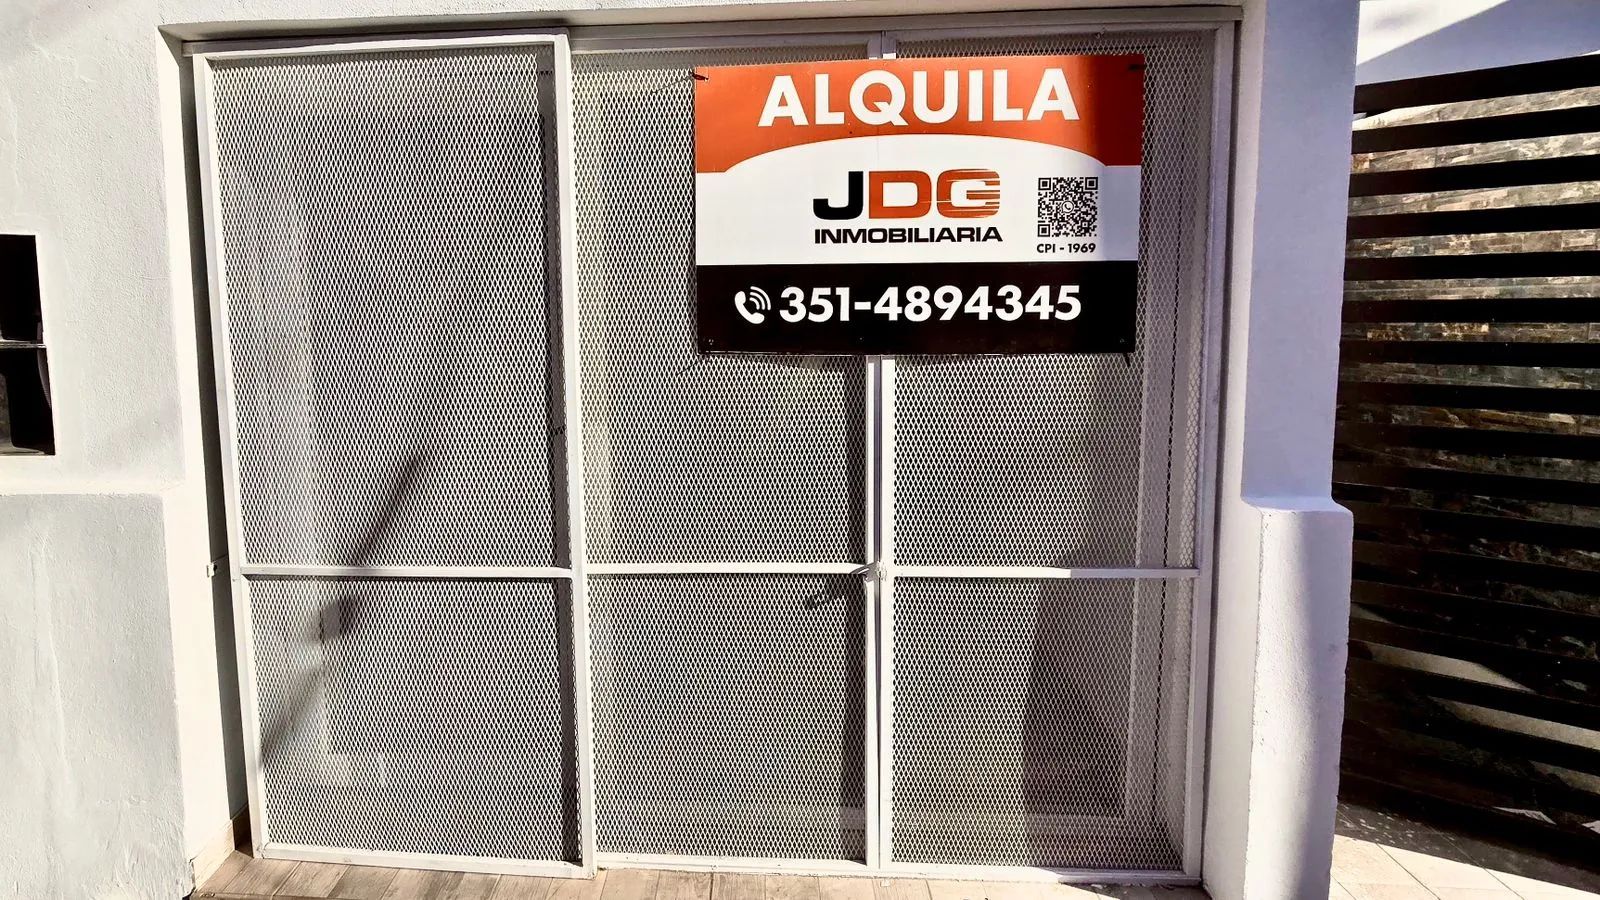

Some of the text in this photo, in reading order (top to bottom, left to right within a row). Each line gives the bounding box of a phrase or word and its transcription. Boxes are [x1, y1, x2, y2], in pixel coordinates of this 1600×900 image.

[758, 68, 1080, 127] ALQUILA
[813, 168, 1001, 220] JDG
[814, 226, 1003, 244] INMOBILIARIA
[1036, 243, 1056, 254] CPI
[1067, 242, 1097, 254] 1969
[779, 285, 1082, 323] 351-4894345
